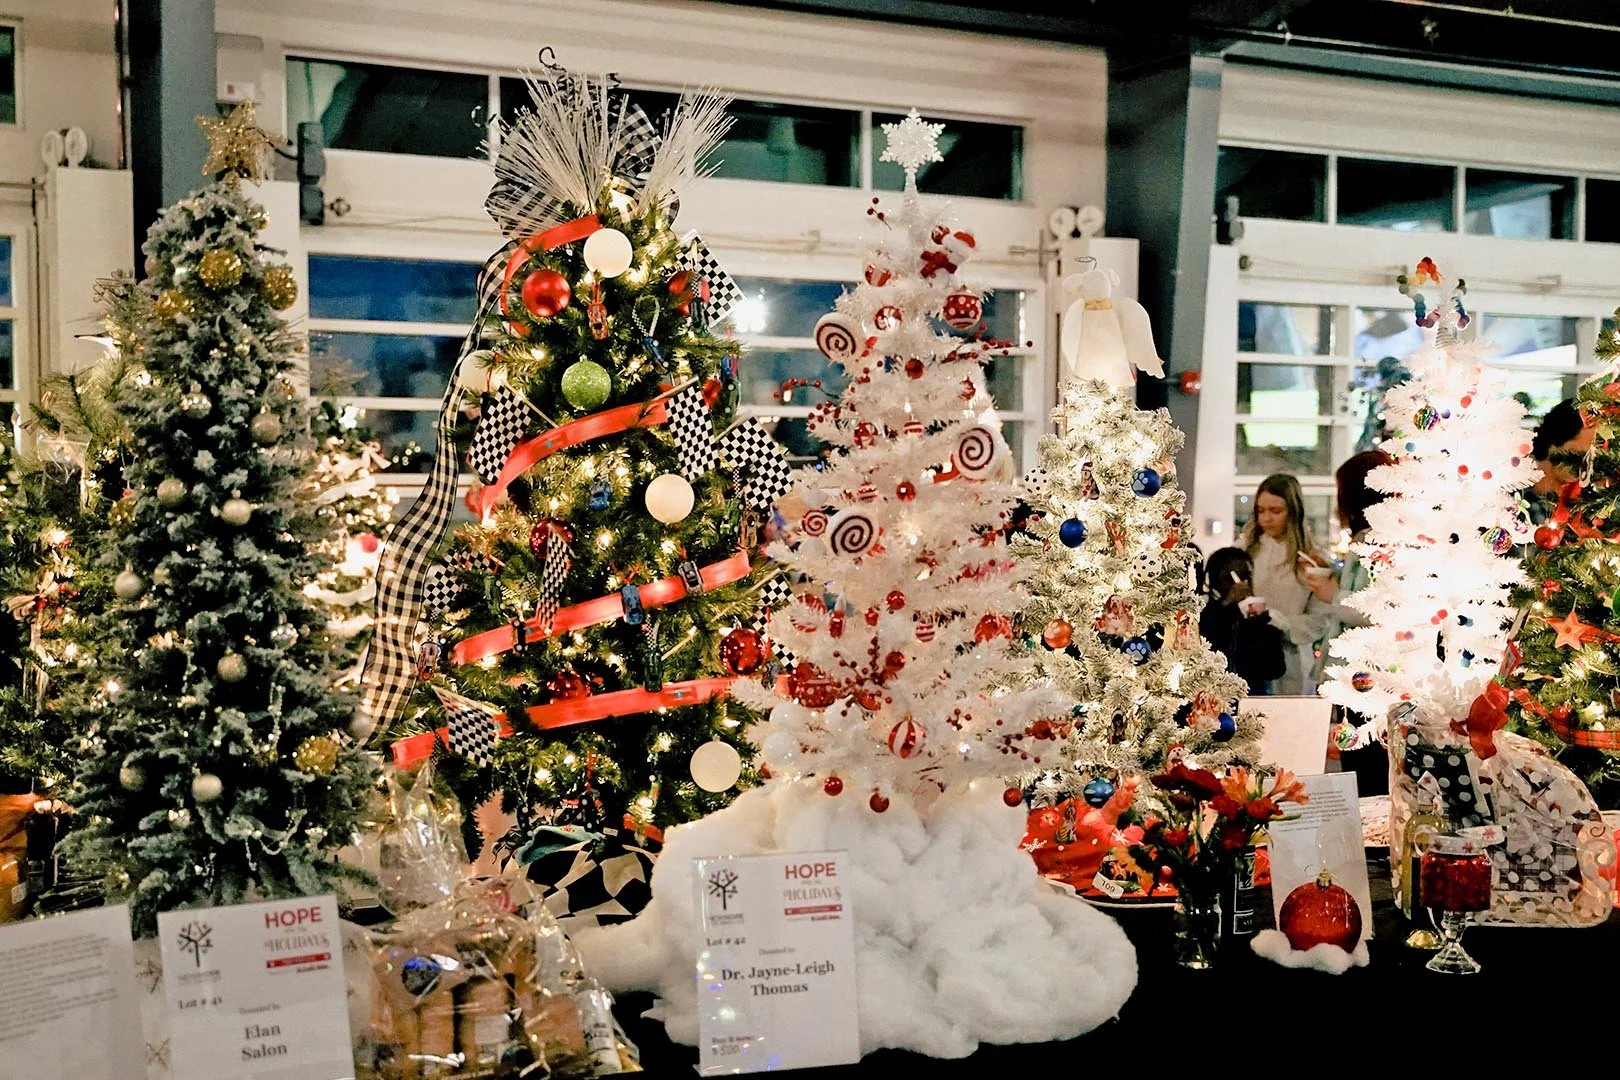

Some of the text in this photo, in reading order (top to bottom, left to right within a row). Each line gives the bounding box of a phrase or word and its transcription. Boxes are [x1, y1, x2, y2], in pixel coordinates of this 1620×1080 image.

[785, 862, 837, 880] HOPE
[783, 886, 842, 901] HOLIDAYS
[264, 906, 323, 929] HOPE
[706, 938, 722, 947] Lot
[721, 960, 835, 981] Dr. Jayne-Leigh
[750, 982, 808, 997] Thomas
[178, 998, 198, 1011] Lot
[244, 1022, 281, 1041] Elan
[241, 1043, 288, 1062] Salon
